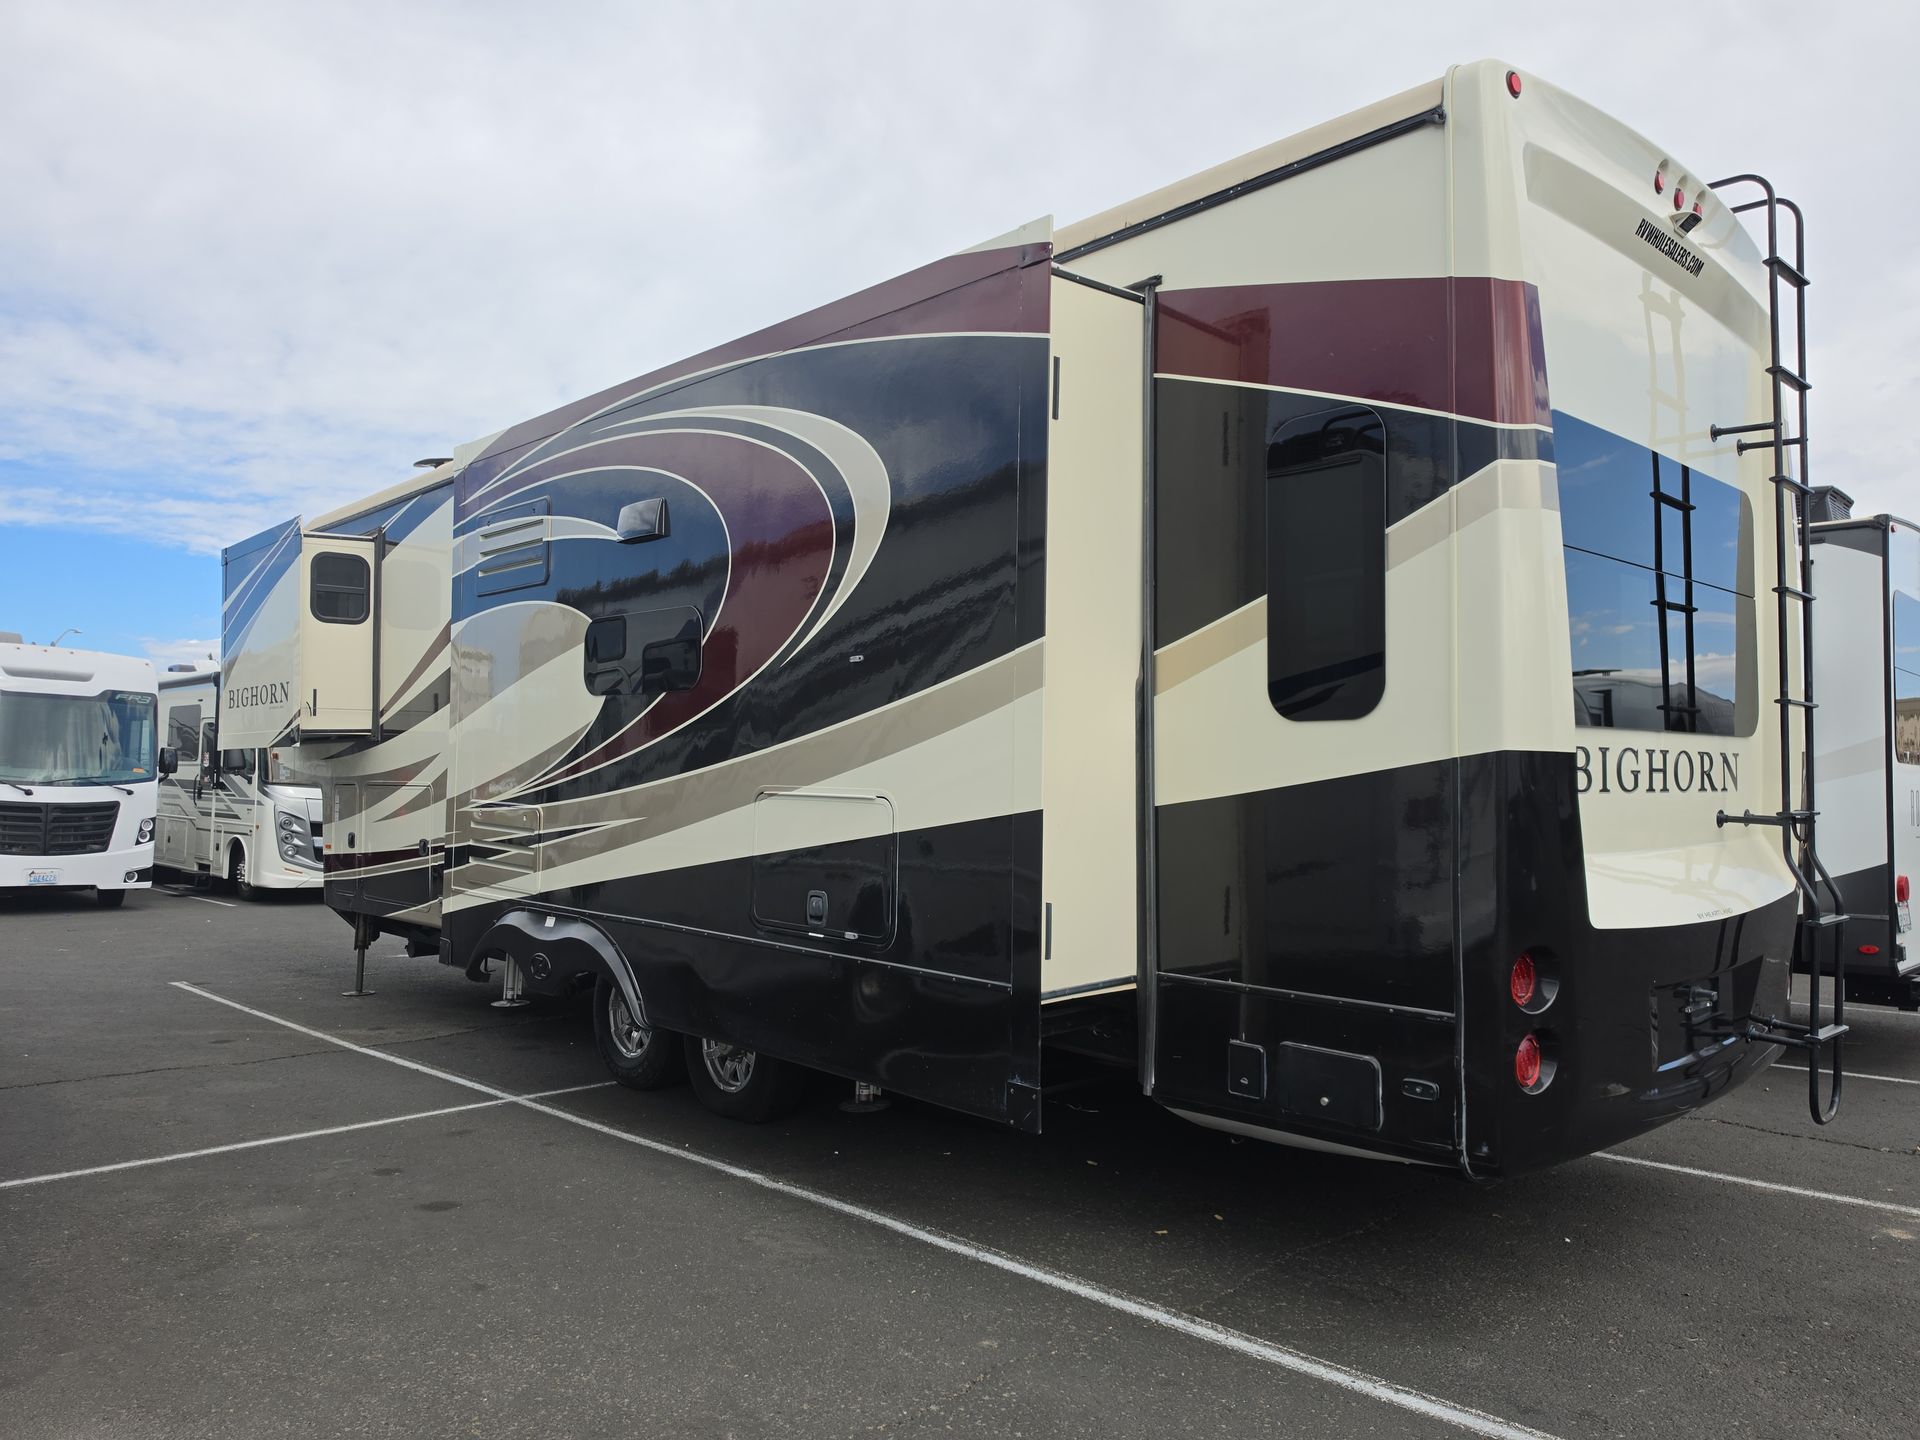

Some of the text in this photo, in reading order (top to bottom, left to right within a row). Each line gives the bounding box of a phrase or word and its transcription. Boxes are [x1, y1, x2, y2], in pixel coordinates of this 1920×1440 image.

[1635, 218, 1705, 278] RVWHOLESALERS.COM
[115, 693, 152, 705] FR3
[228, 681, 290, 710] BIGHORN
[1576, 745, 1739, 793] BIGHORN
